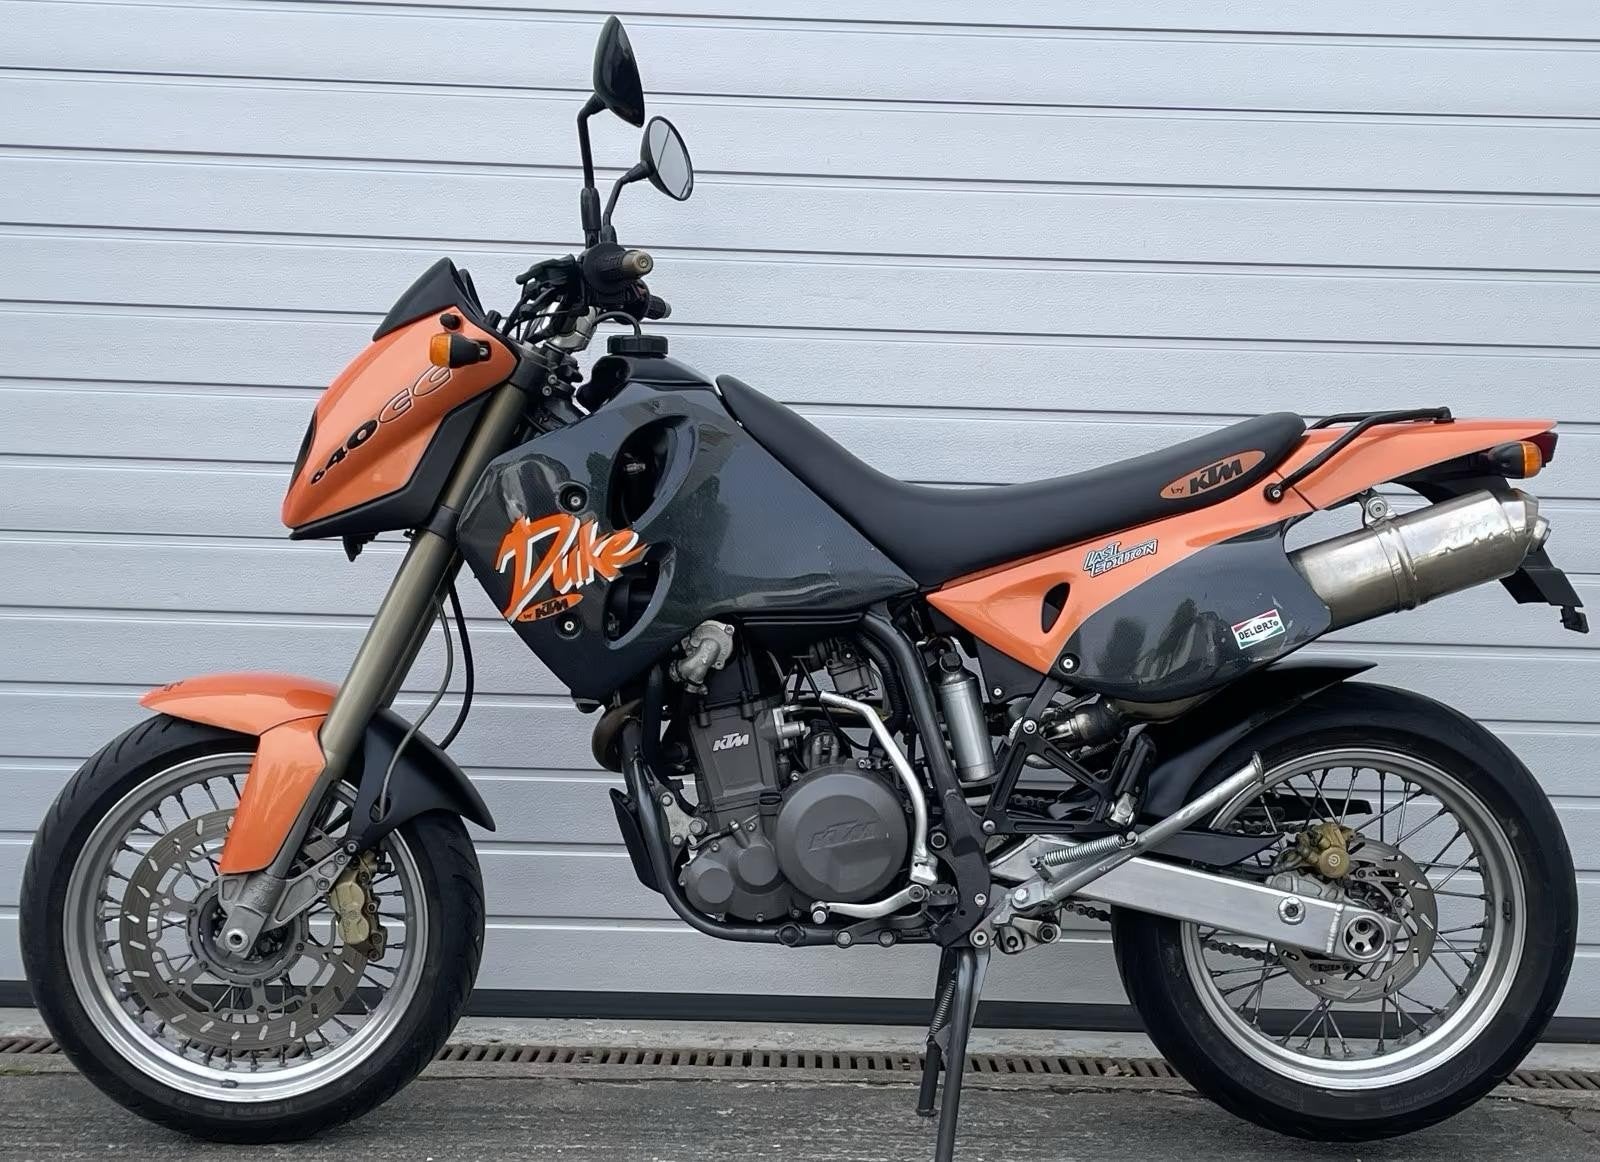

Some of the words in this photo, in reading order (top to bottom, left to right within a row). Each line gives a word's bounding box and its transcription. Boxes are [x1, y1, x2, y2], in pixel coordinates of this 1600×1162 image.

[1190, 459, 1243, 494] KTM
[495, 513, 650, 624] Duke
[1084, 541, 1121, 571] LAST
[1091, 540, 1158, 577] EDITION
[535, 598, 568, 619] KTM
[713, 733, 749, 751] KTM
